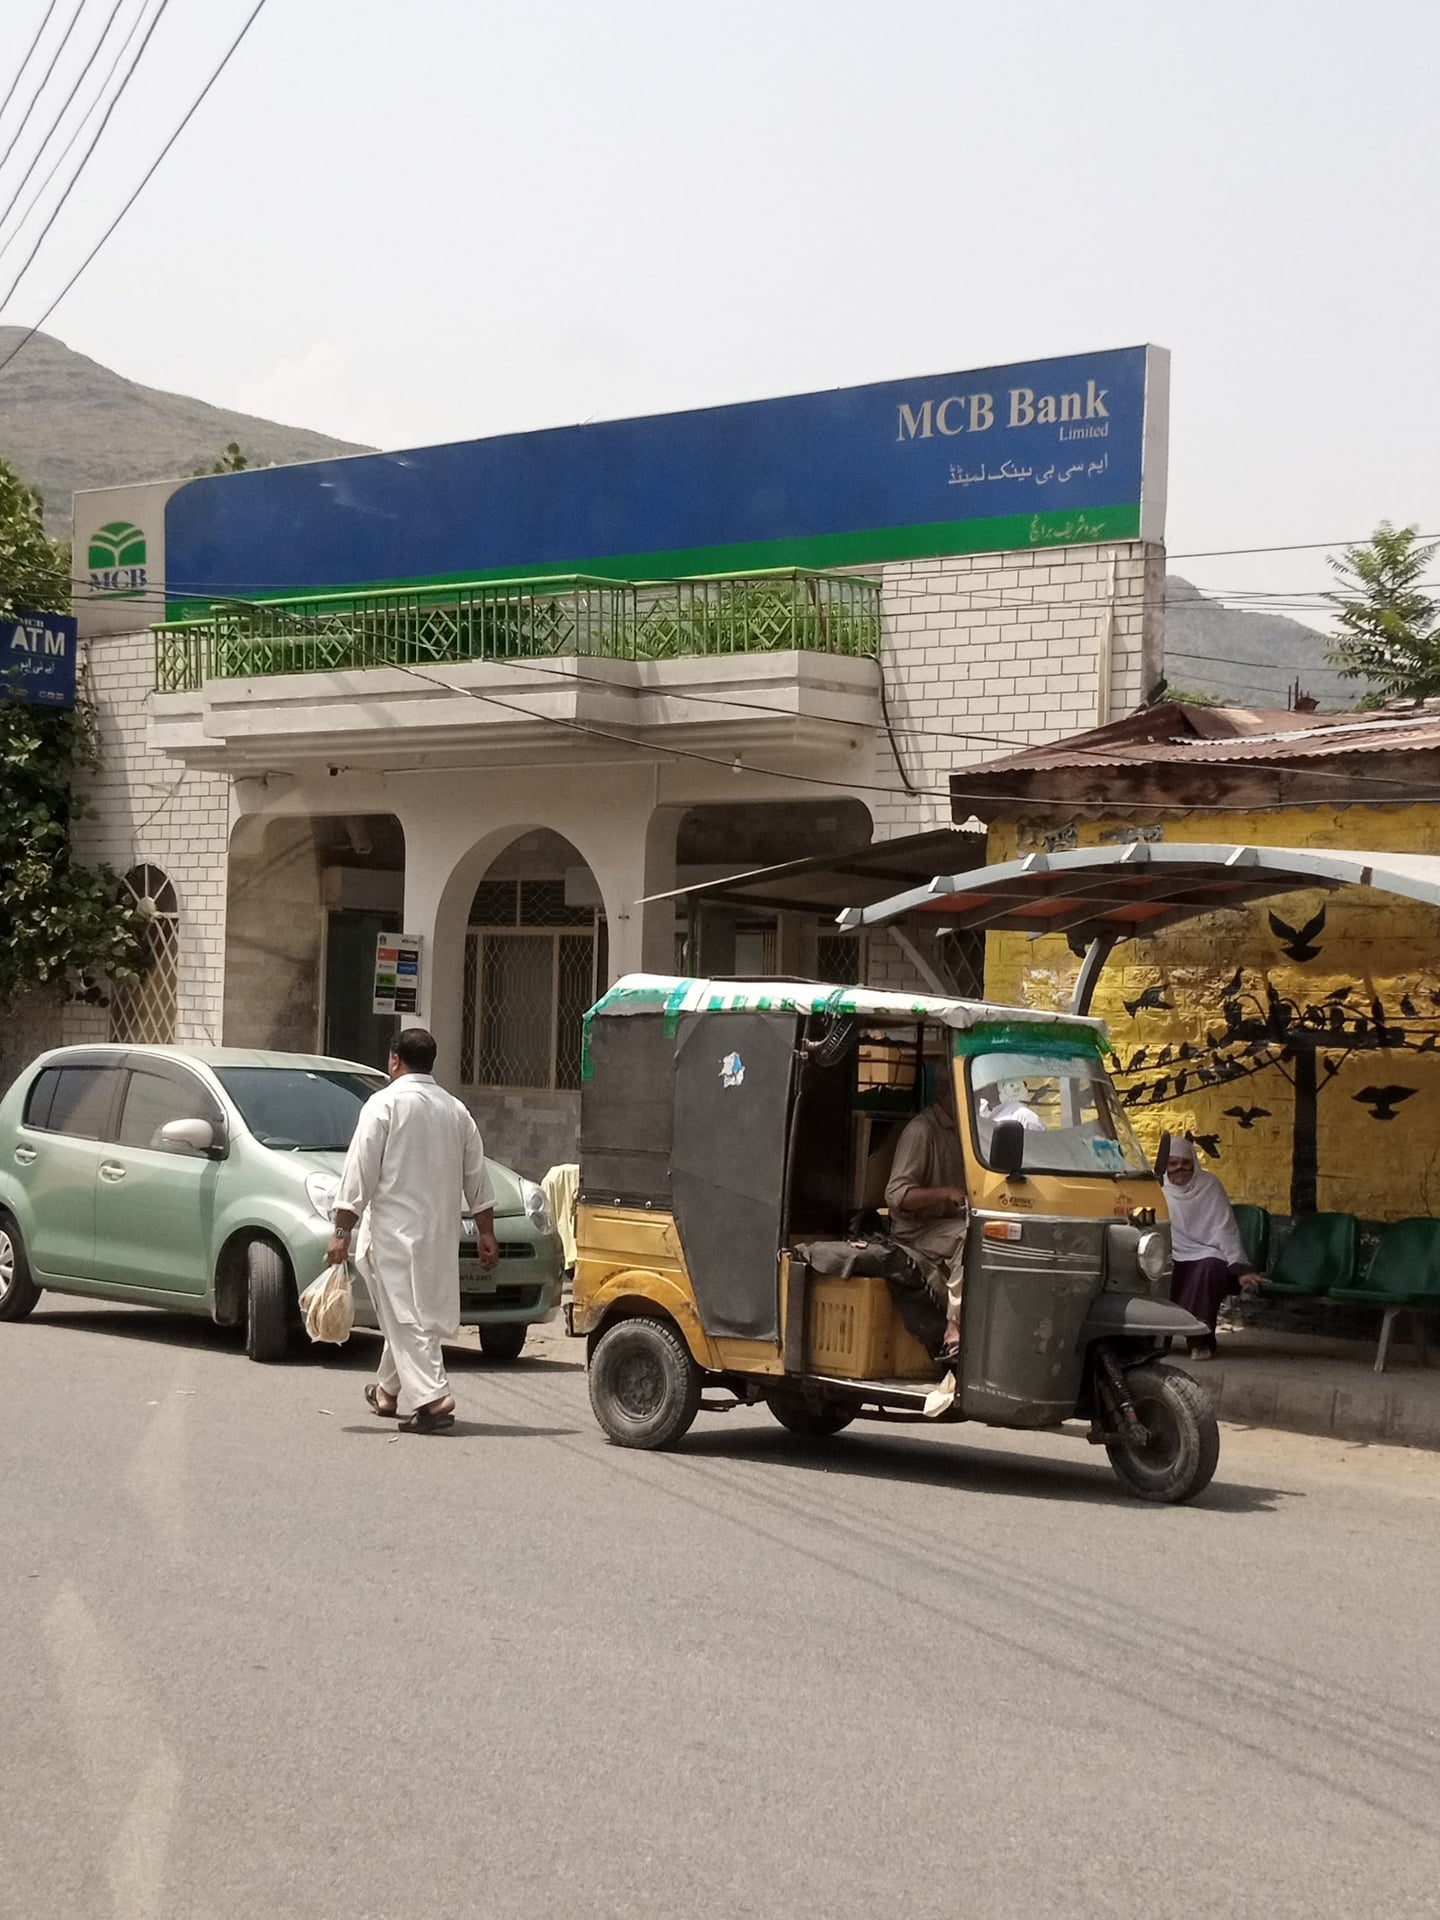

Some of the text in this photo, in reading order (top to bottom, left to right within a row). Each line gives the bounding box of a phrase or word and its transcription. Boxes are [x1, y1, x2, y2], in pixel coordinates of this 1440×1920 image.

[896, 380, 1110, 442] MCB Bank
[1059, 422, 1109, 441] Limited
[988, 459, 1033, 481] بینک
[1035, 464, 1055, 484] بی
[1058, 462, 1084, 482] سی
[1088, 453, 1108, 478] ایم
[90, 568, 147, 592] MCB
[10, 625, 65, 656] ATM
